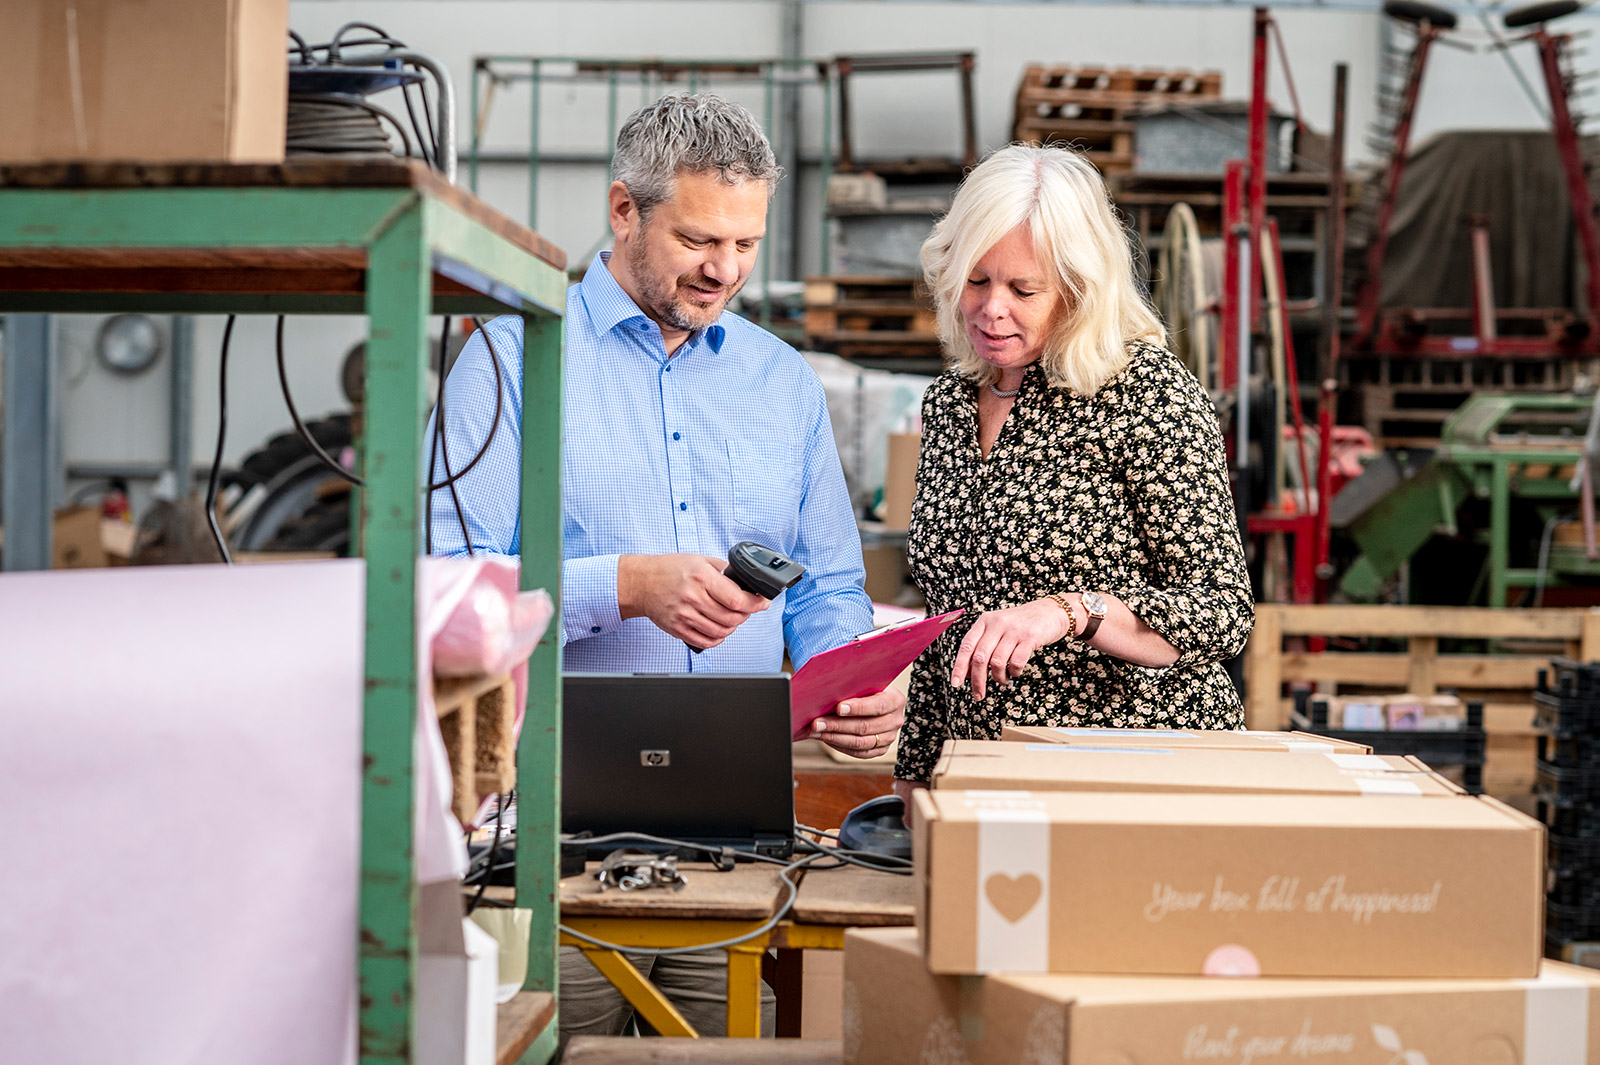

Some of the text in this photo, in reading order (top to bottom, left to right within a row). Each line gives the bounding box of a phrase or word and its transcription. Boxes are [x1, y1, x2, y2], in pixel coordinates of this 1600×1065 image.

[646, 751, 665, 766] hp
[1209, 873, 1250, 914] box
[1256, 874, 1300, 913] full
[1305, 874, 1337, 913] of
[1330, 873, 1442, 923] happiness!
[1239, 1035, 1288, 1065] your
